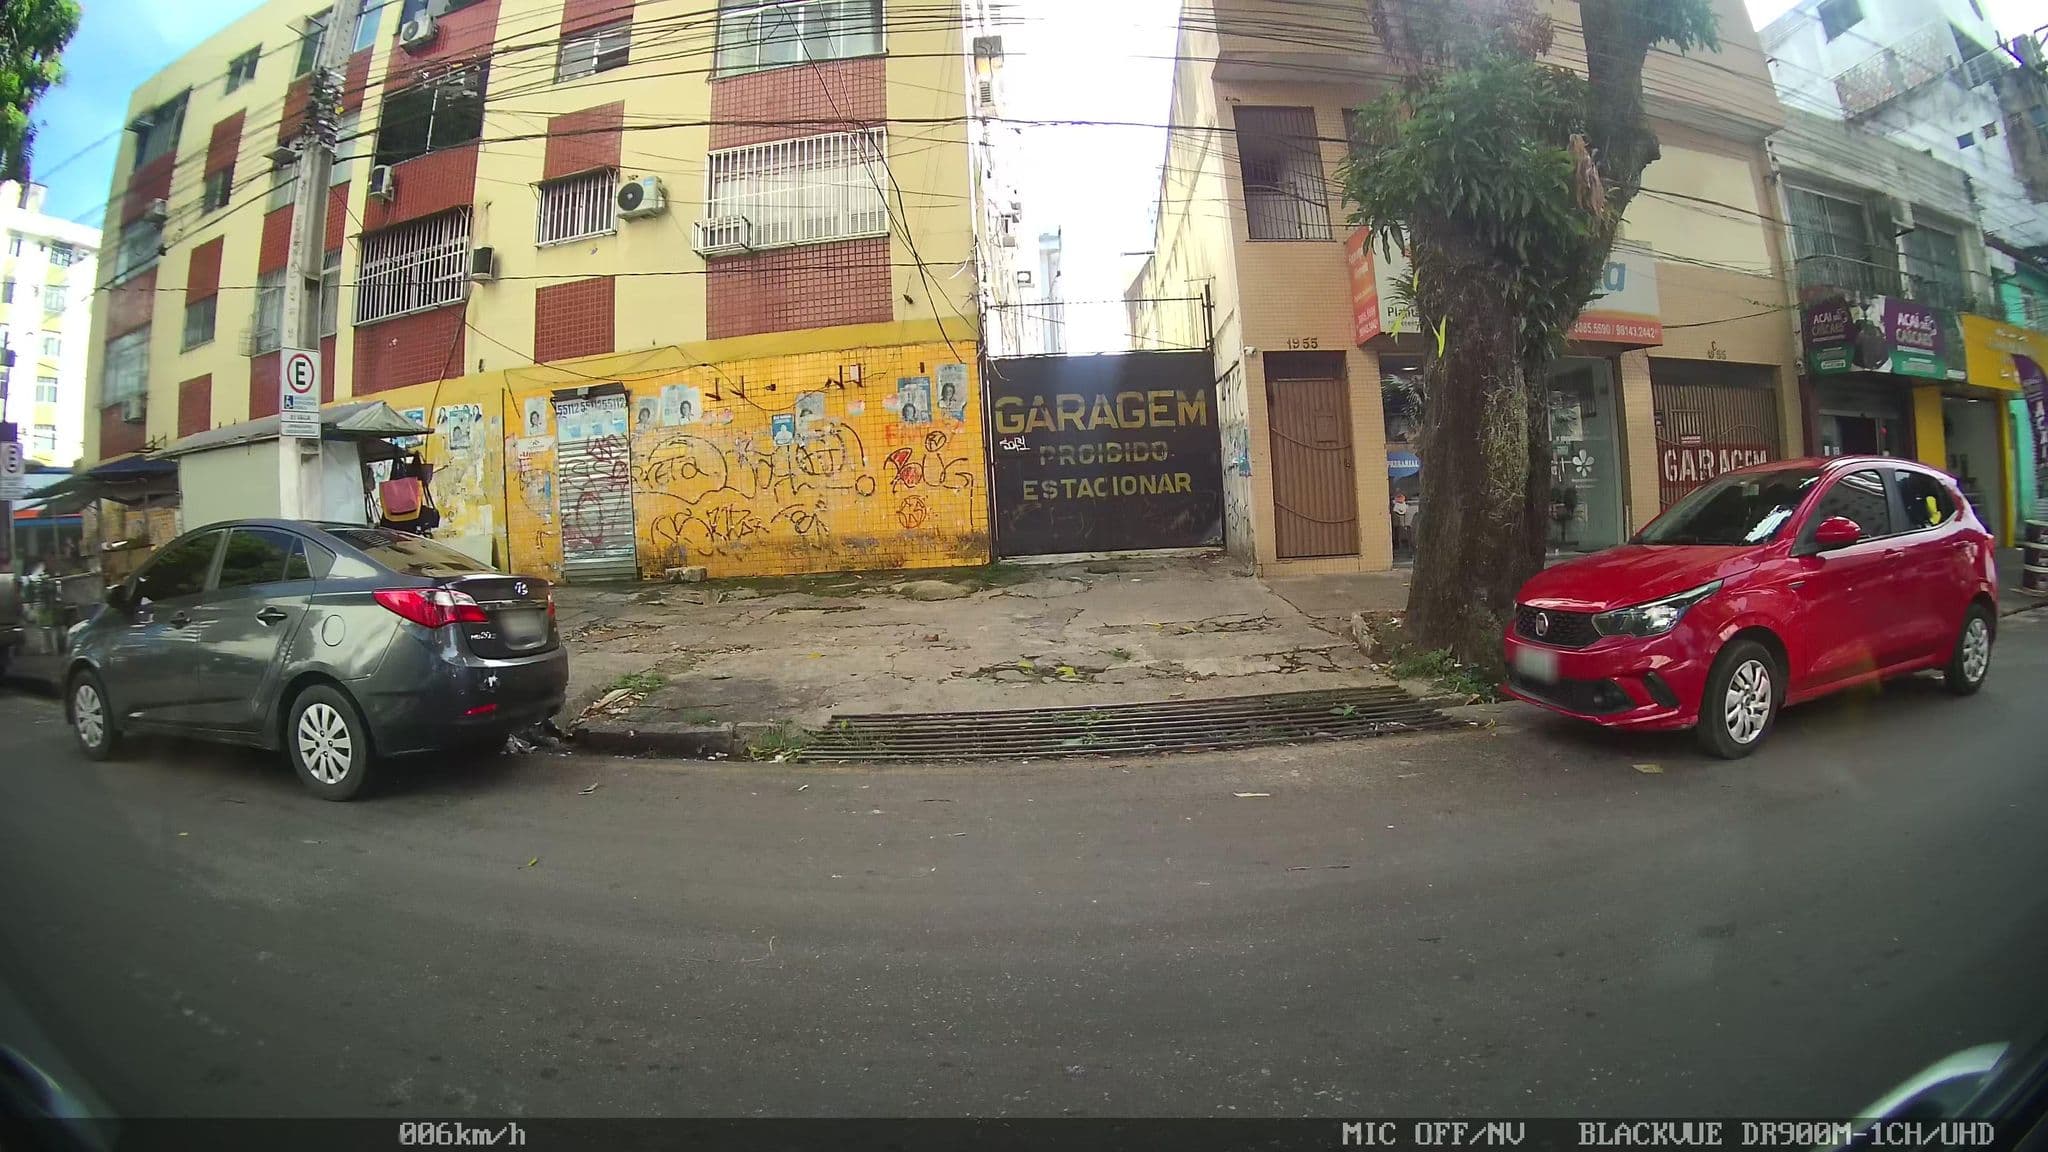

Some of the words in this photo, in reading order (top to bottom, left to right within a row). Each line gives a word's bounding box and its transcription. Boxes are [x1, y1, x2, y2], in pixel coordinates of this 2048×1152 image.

[1286, 336, 1319, 349] 1955
[296, 361, 306, 385] E
[994, 389, 1207, 434] GARAGEM
[1039, 441, 1169, 466] PROIBIDO
[1022, 472, 1192, 500] ESTACIONAR
